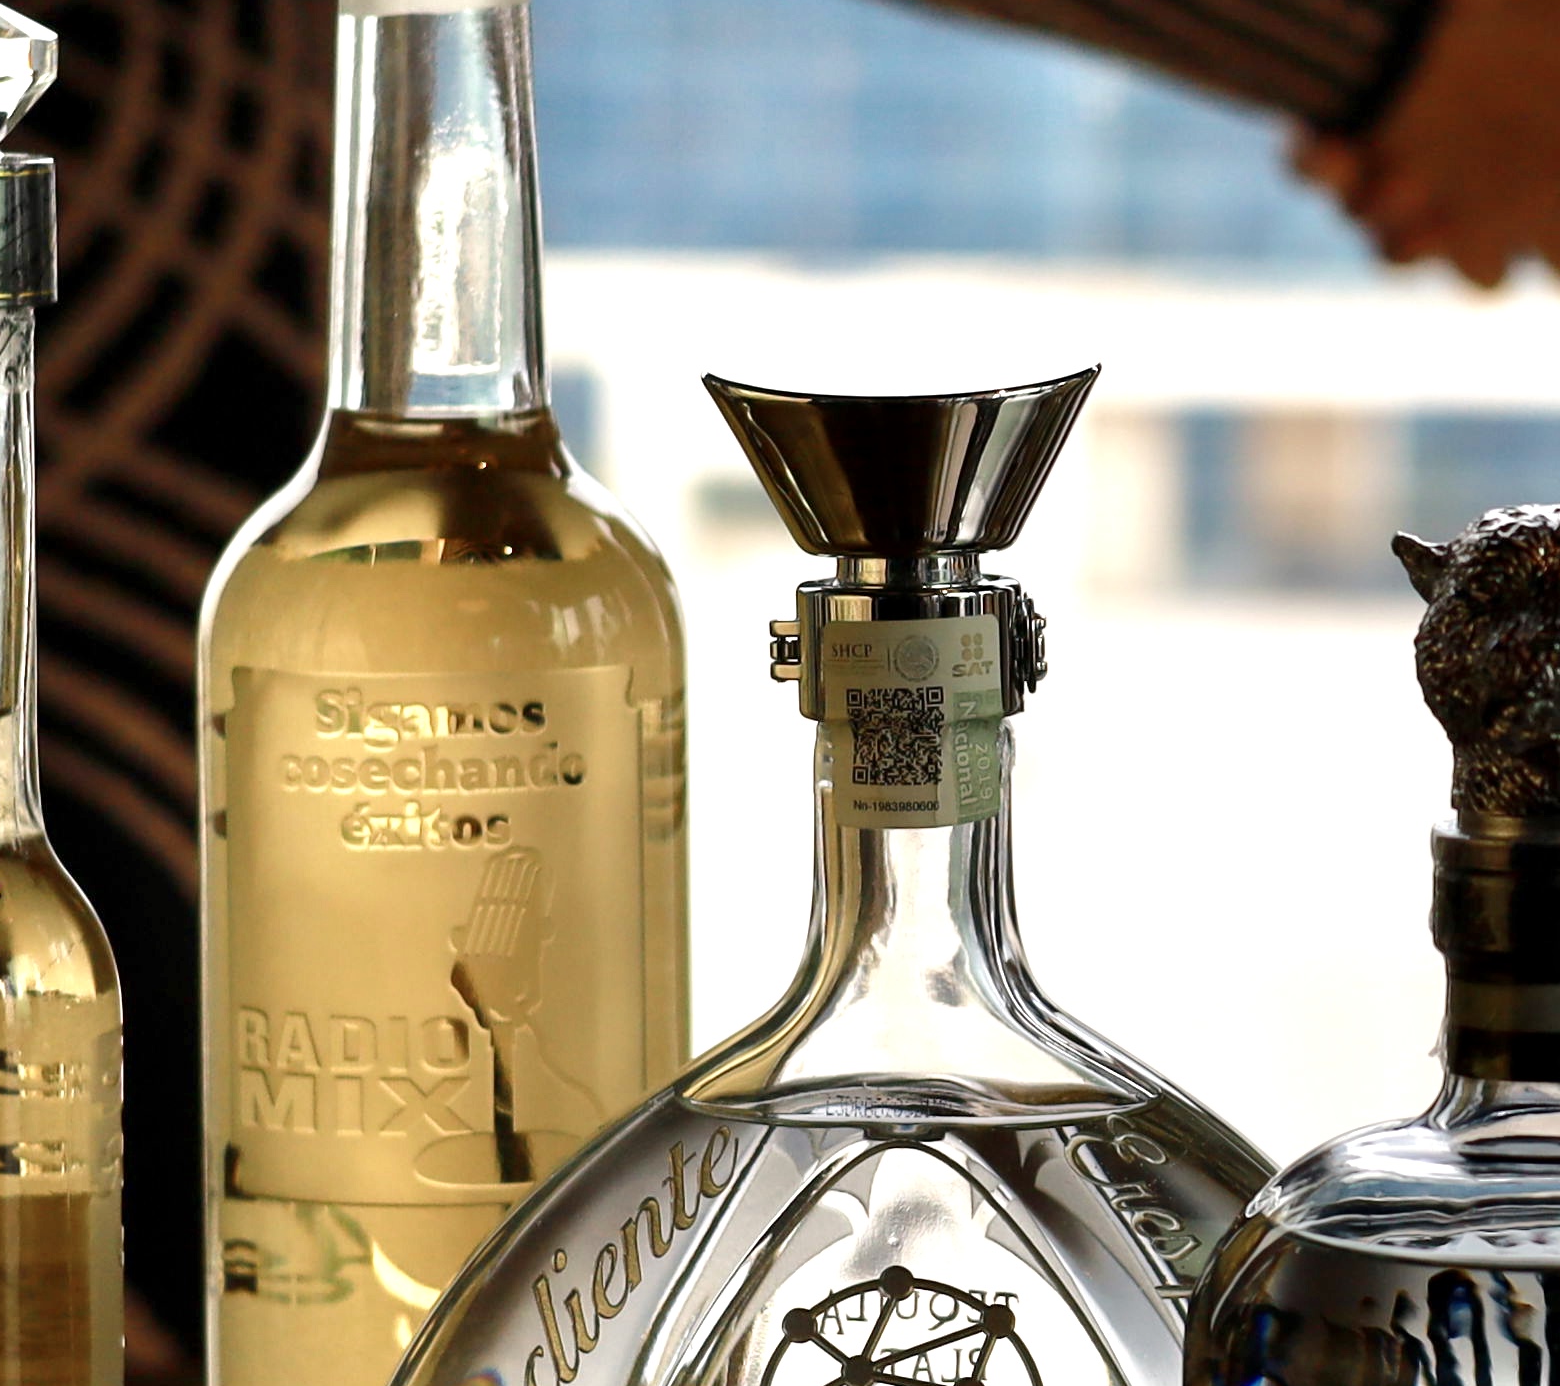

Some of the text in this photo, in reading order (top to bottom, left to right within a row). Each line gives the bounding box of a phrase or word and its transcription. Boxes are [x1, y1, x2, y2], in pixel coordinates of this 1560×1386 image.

[830, 643, 873, 659] SHCP
[951, 660, 993, 678] SAT
[315, 686, 549, 750] Sigamos
[280, 741, 586, 795] cosechando
[952, 699, 980, 806] Nacional
[972, 741, 994, 801] 2019
[340, 799, 514, 853] éxitos
[239, 1004, 472, 1072] RADIO
[239, 1069, 476, 1138] MIX
